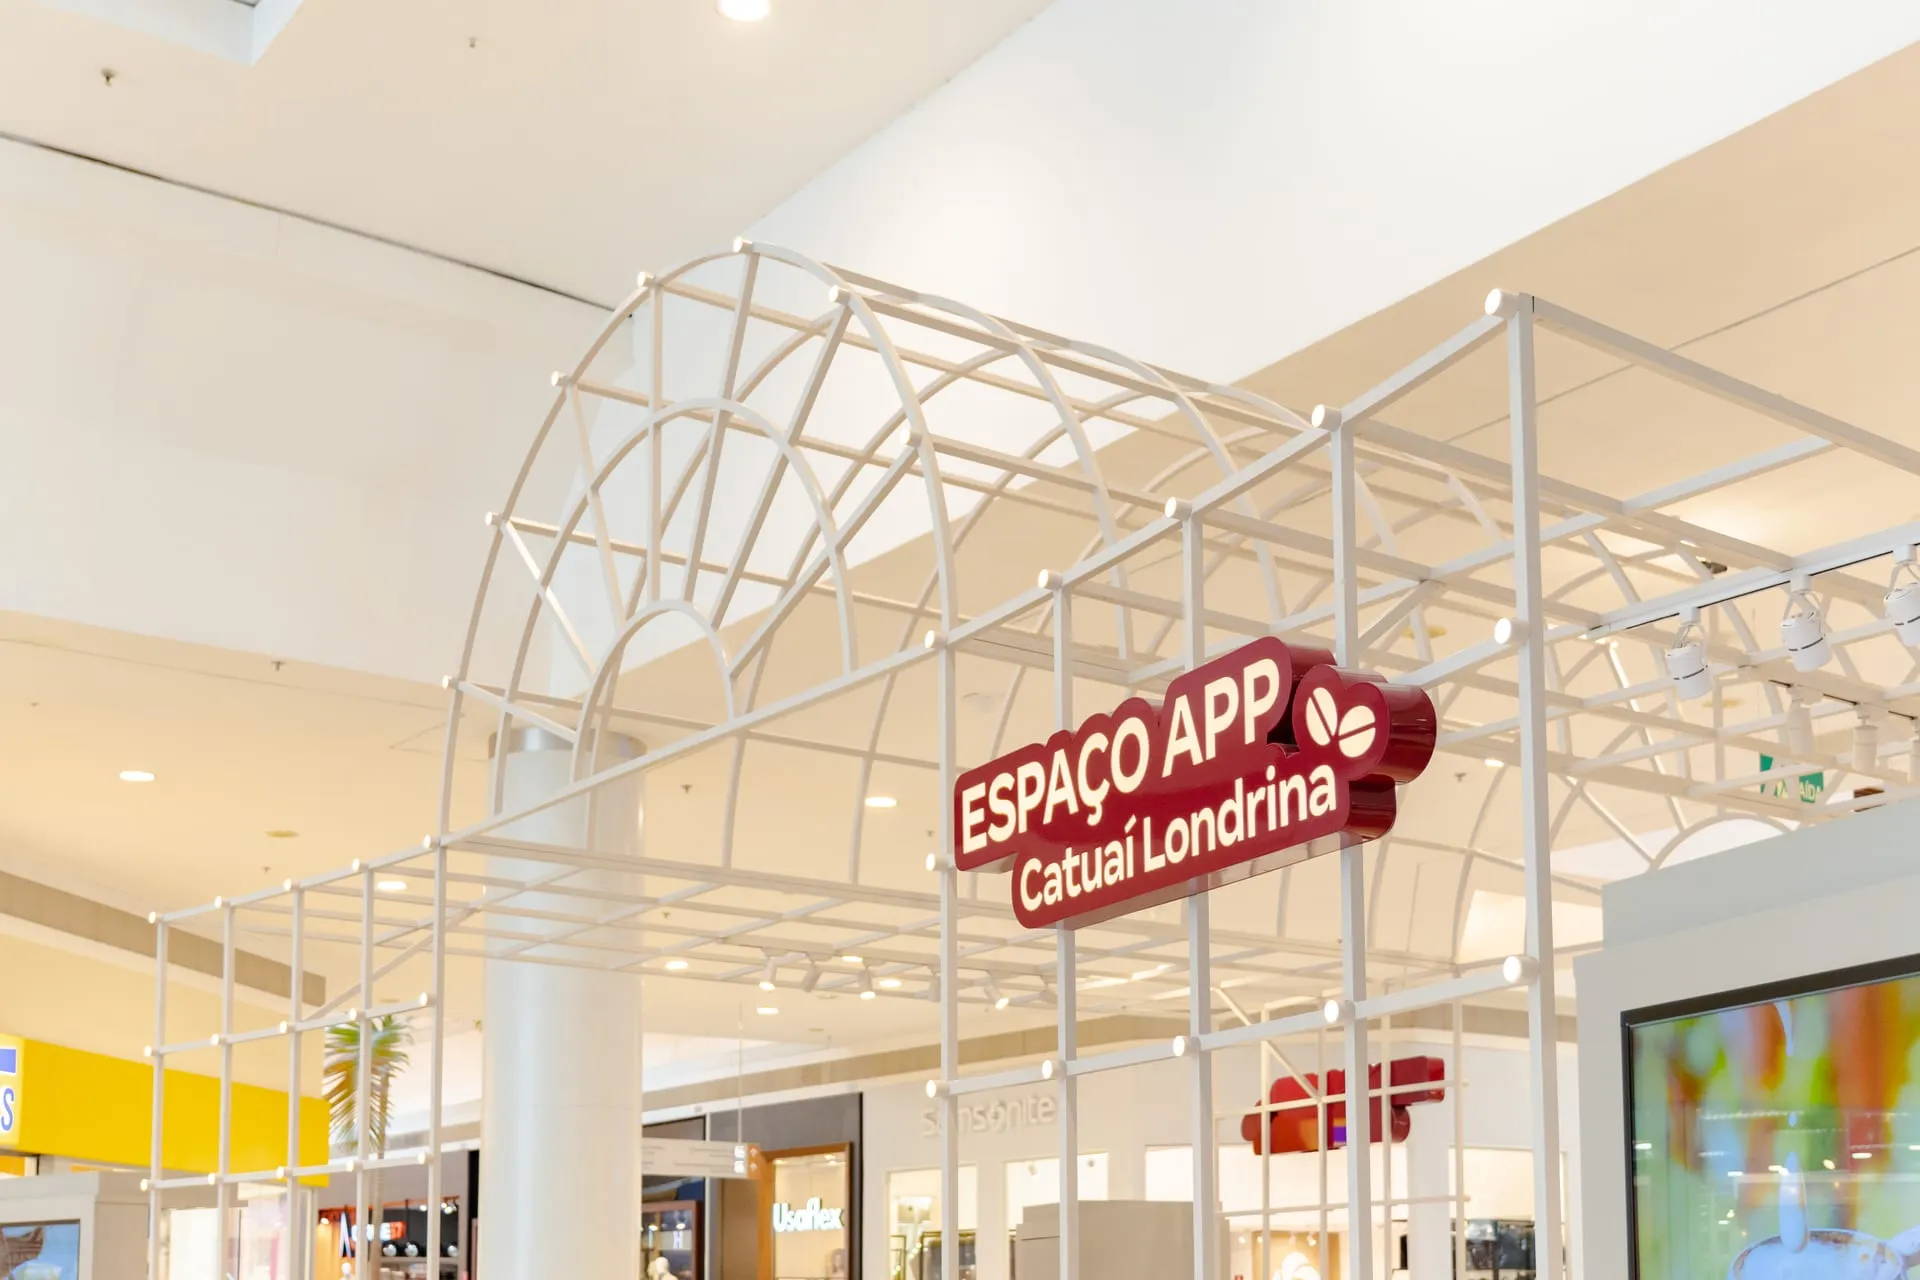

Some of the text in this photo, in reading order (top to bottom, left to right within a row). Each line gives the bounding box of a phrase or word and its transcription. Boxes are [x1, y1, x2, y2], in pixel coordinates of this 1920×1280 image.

[961, 658, 1280, 854] ESPAÇO APP
[1019, 763, 1337, 912] Catuaí Londrina
[773, 1197, 844, 1232] Usaflex
